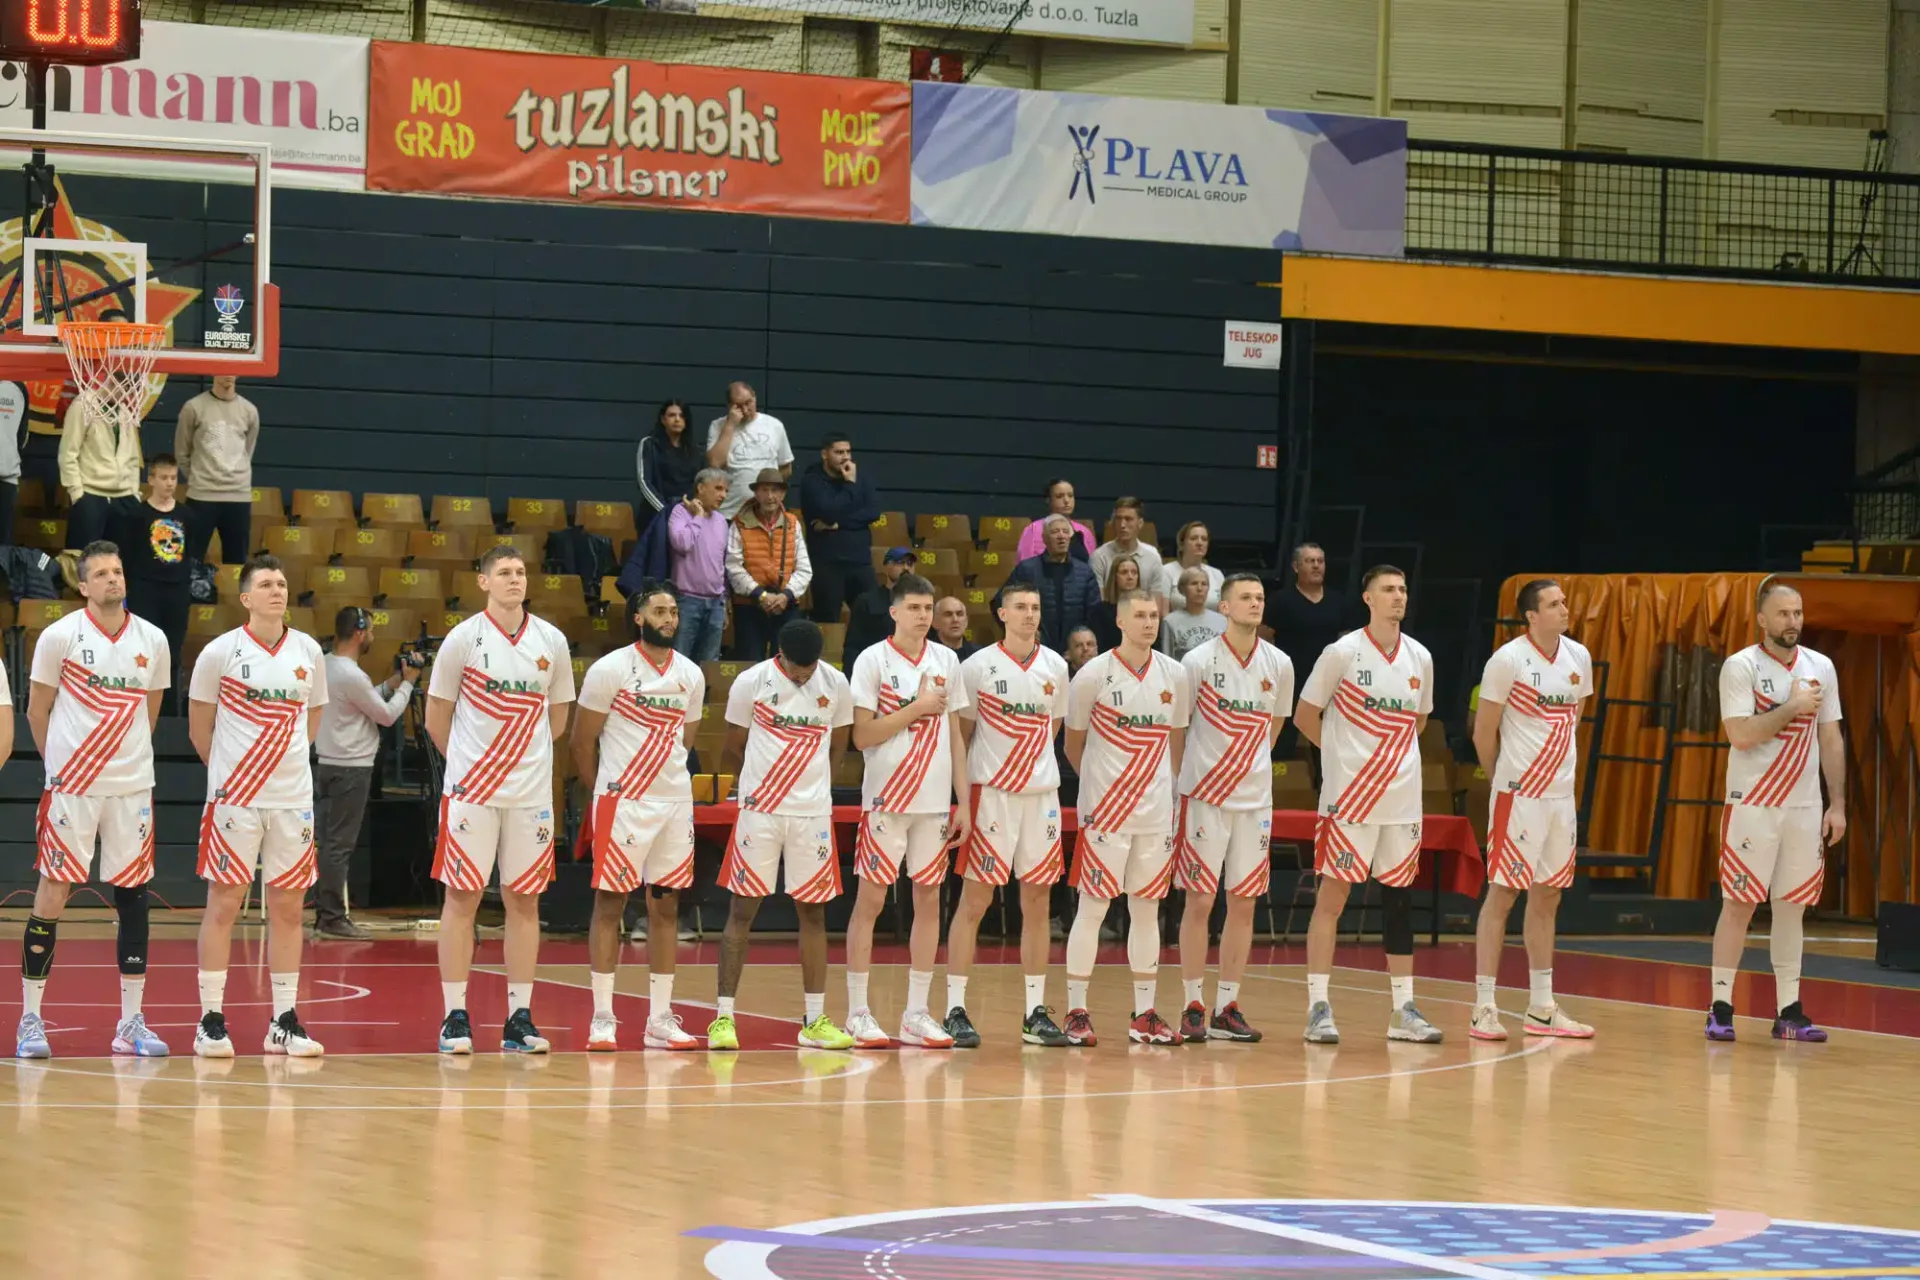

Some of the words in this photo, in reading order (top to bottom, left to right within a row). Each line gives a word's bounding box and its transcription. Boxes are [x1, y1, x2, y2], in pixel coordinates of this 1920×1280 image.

[1039, 4, 1088, 22] d.o.o.
[1094, 6, 1139, 26] Tuzla
[410, 77, 462, 117] MOJ
[506, 64, 783, 166] tuzlanski
[821, 107, 885, 148] MOJE
[395, 120, 476, 160] GRAD
[823, 148, 881, 188] PIVO
[1102, 136, 1249, 188] PLAVA
[567, 154, 729, 198] pilsner
[1147, 184, 1201, 201] MEDICAL
[1204, 187, 1248, 204] GROUP
[204, 330, 252, 342] EUROBASKET
[1229, 330, 1279, 344] TELESKOP
[204, 340, 250, 350] QUALIFIERS
[1243, 346, 1263, 359] JUG
[452, 499, 473, 512] 32
[933, 515, 948, 529] 39
[994, 518, 1011, 531] 40
[357, 531, 375, 545] 30
[919, 552, 937, 566] 38
[328, 569, 347, 583] 29
[81, 649, 95, 665] 13
[483, 653, 489, 669] 1
[88, 673, 127, 690] PAN
[634, 679, 642, 691] 2
[891, 675, 900, 689] 8
[1212, 672, 1225, 689] 12
[1356, 669, 1373, 686] 20
[245, 687, 287, 701] PAN
[485, 679, 528, 693] PAN
[994, 679, 1008, 695] 10
[1761, 678, 1775, 694] 21
[634, 695, 671, 709] PAN
[1112, 690, 1123, 706] 11
[1217, 698, 1254, 713] PAN
[1363, 697, 1404, 712] PAN
[1537, 694, 1565, 706] PAN
[1001, 702, 1036, 716] PAN
[772, 713, 810, 727] PAN
[1116, 714, 1154, 729] PAN
[980, 855, 996, 873] 10
[1335, 850, 1354, 870] 20
[1090, 868, 1103, 887] 11
[1189, 862, 1202, 881] 12
[1732, 873, 1749, 891] 21
